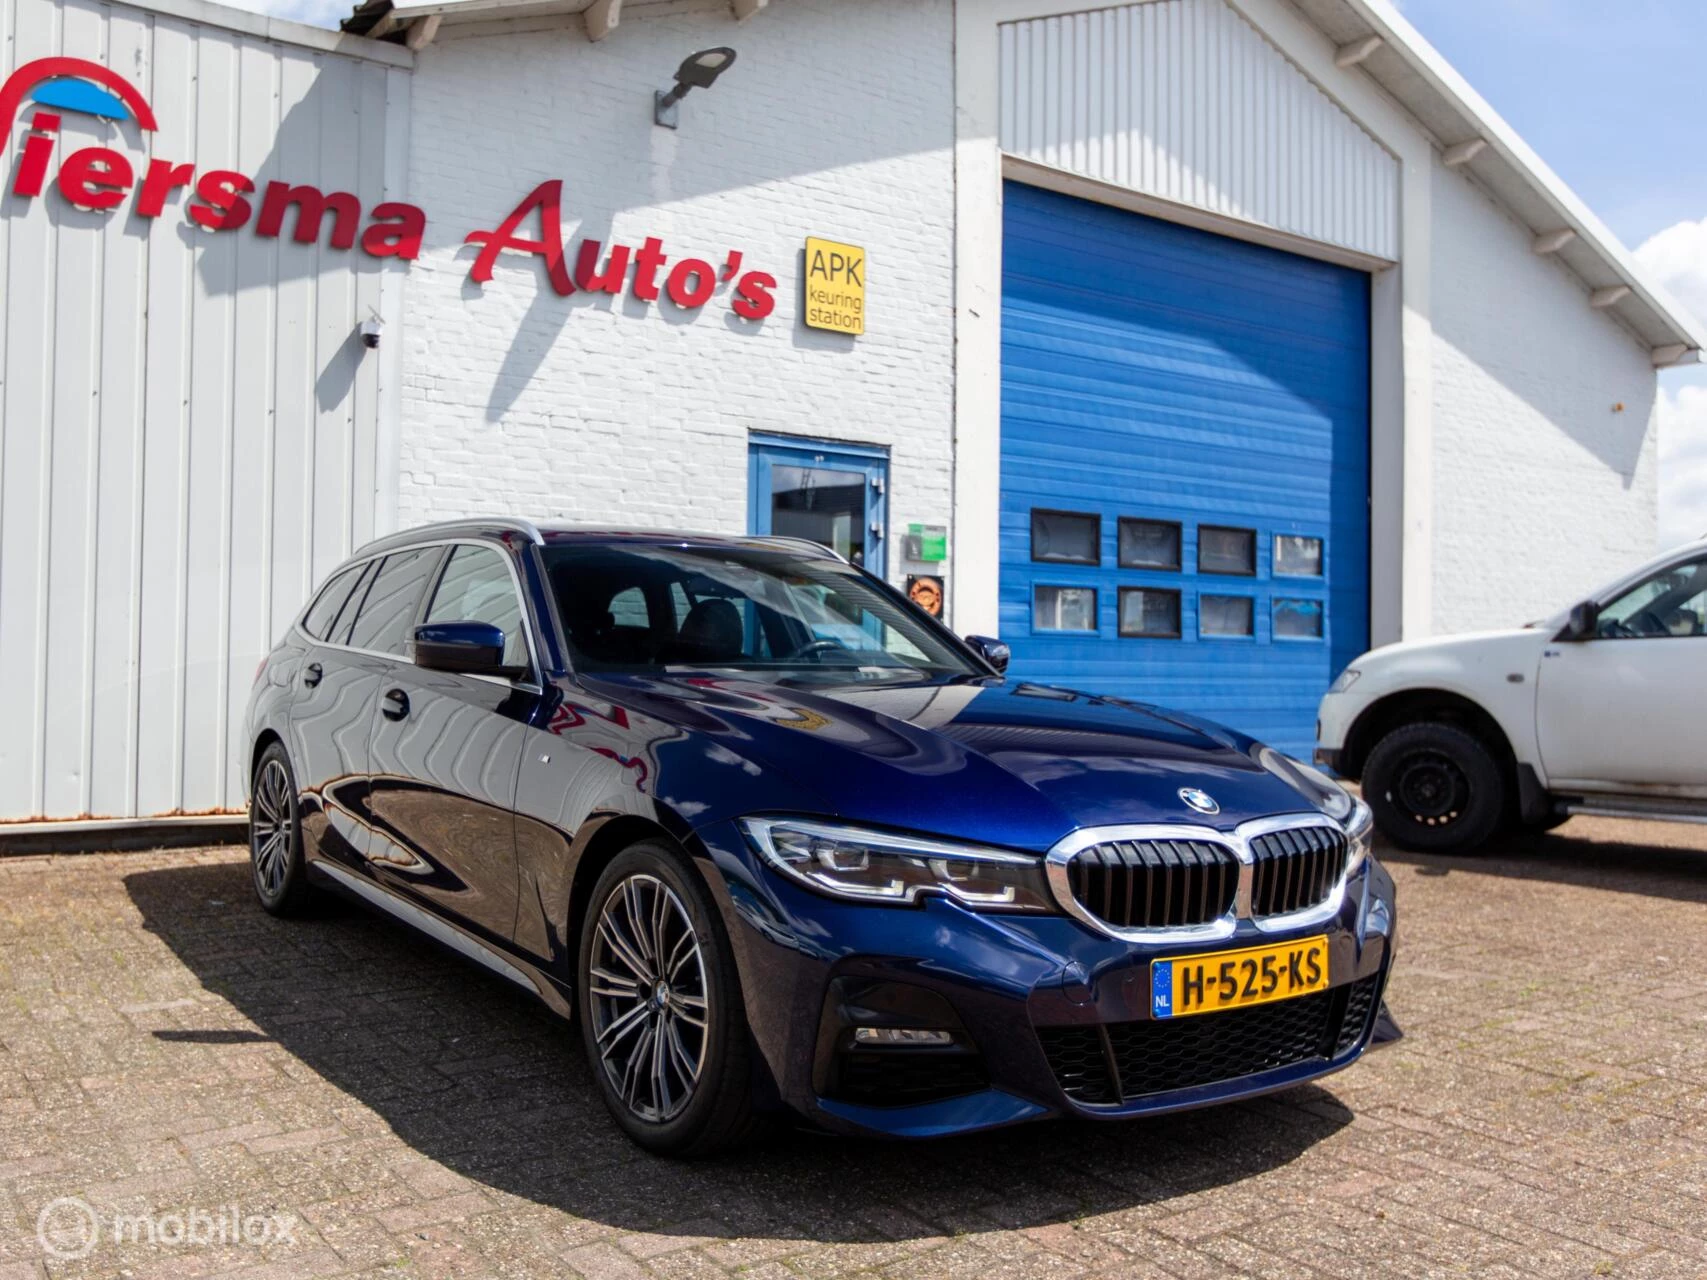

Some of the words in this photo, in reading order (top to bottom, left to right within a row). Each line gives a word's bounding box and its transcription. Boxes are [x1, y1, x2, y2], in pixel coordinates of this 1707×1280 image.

[463, 179, 778, 320] Auto's
[809, 249, 862, 288] APK
[809, 284, 862, 314] keuring
[809, 306, 861, 329] station
[1182, 947, 1322, 1007] H-525-KS
[1155, 995, 1170, 1007] NL
